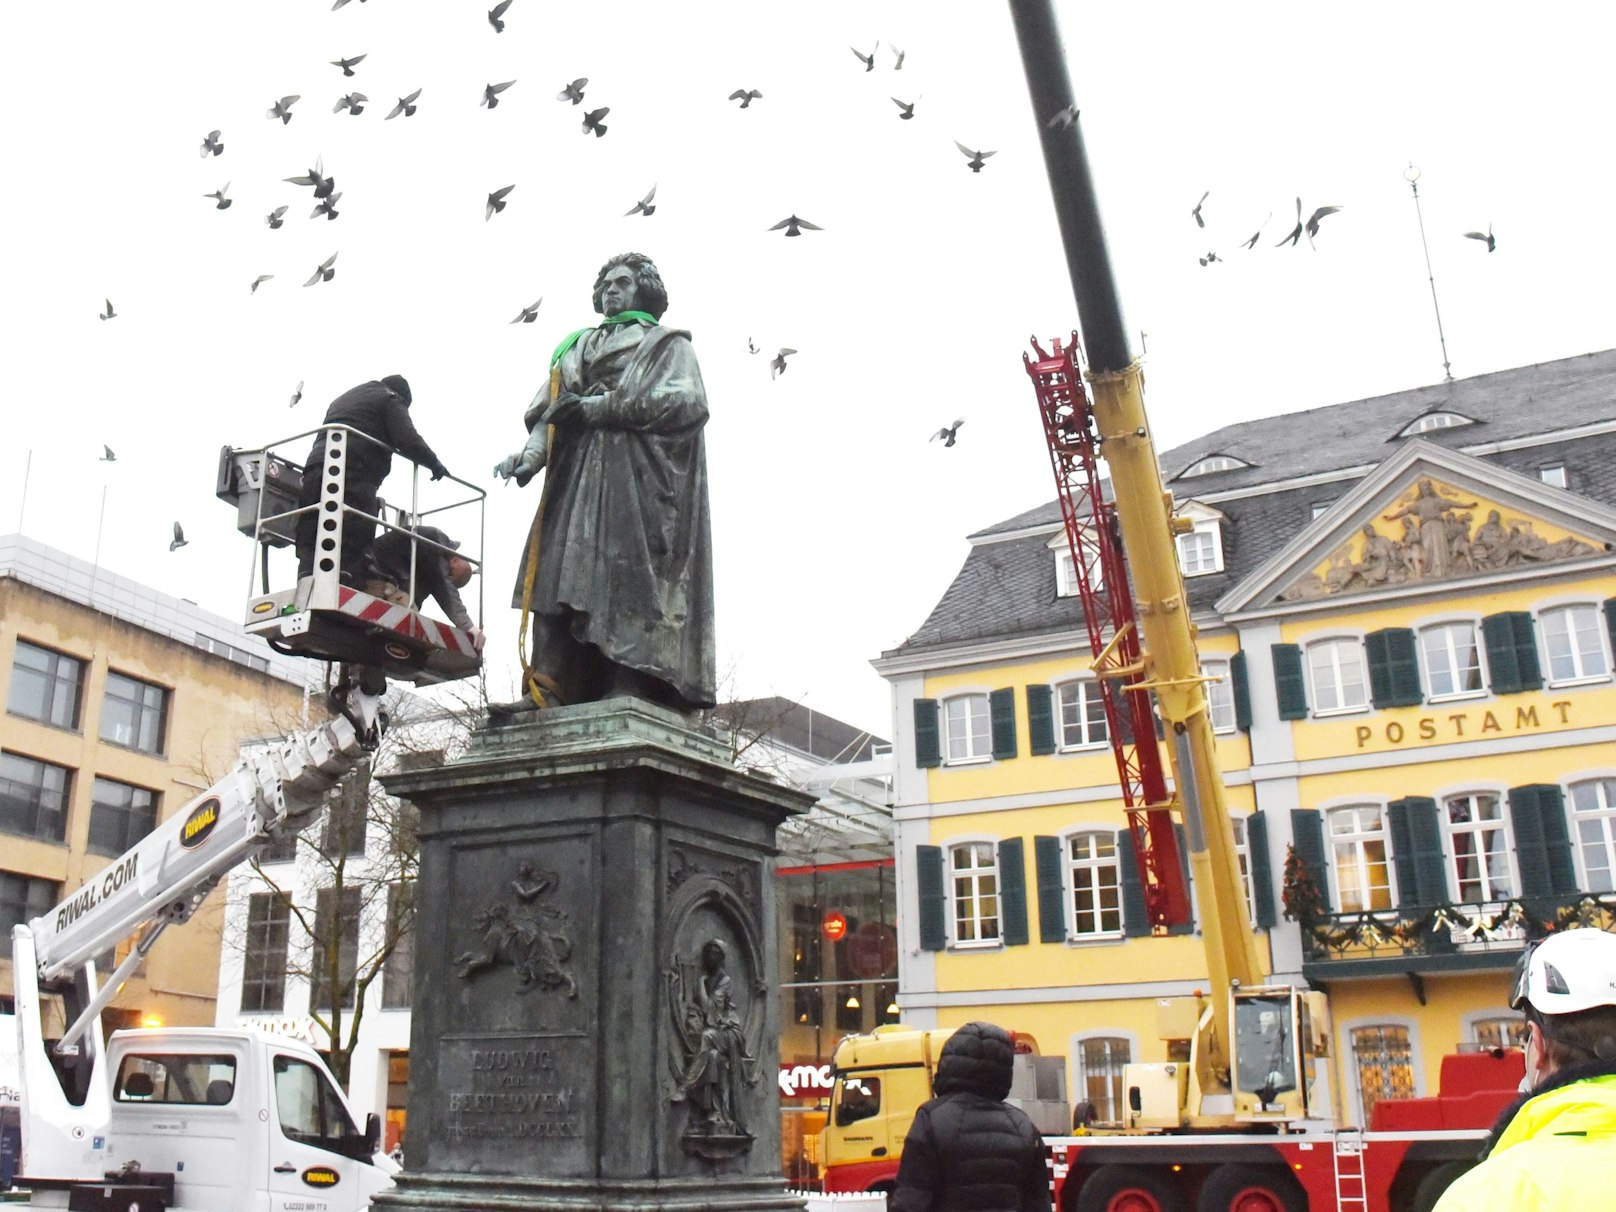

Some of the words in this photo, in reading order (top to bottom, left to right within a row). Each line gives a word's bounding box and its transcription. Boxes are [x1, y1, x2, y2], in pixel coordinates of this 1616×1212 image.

[1355, 700, 1572, 748] POSTAMT
[184, 806, 217, 840] RIWAL
[55, 851, 140, 934] RIWAL.COM
[471, 1050, 553, 1072] LUDWIG
[306, 1171, 336, 1183] RIWAL
